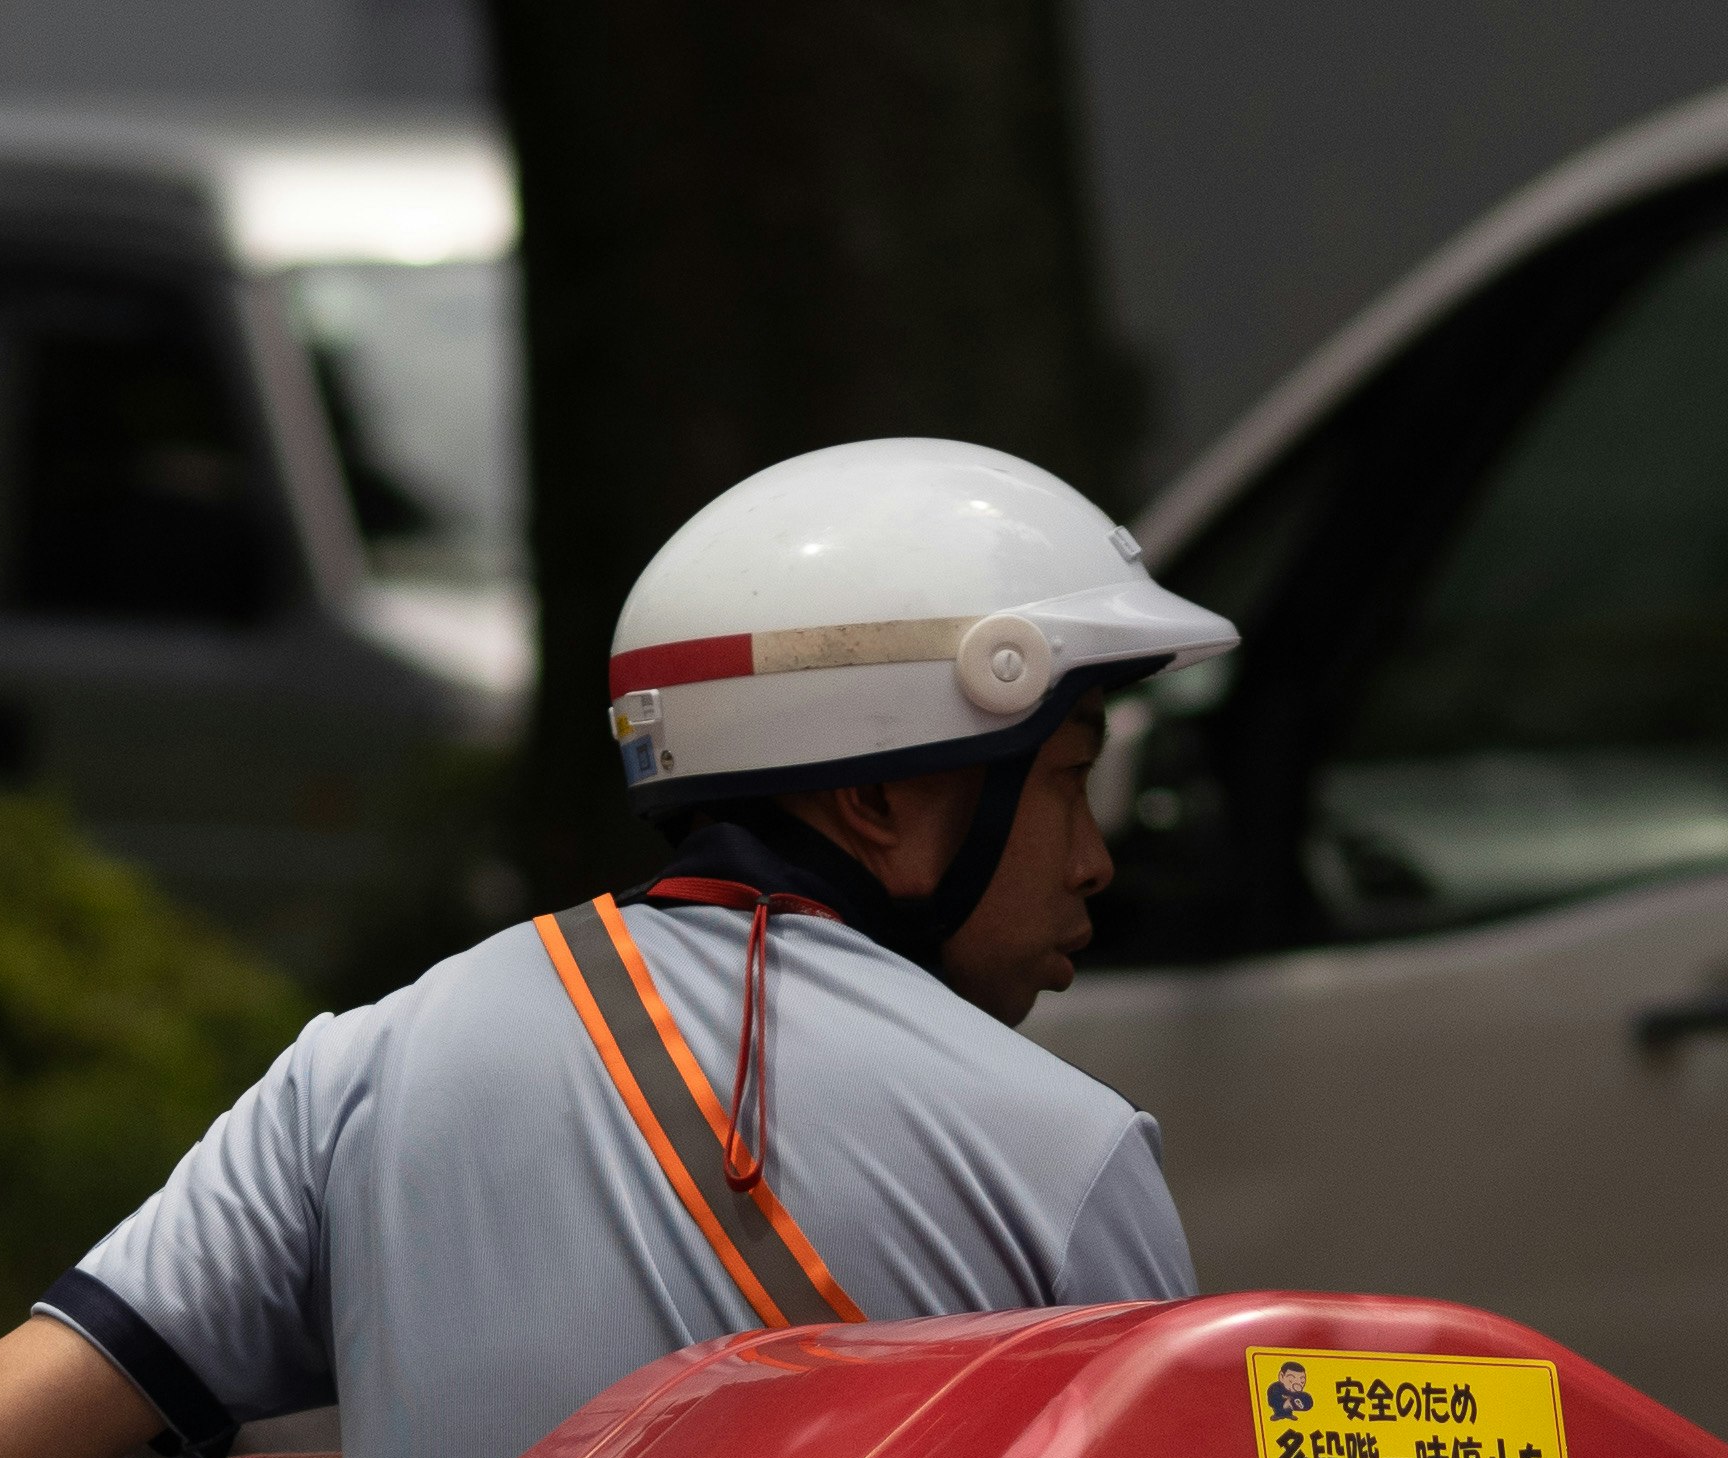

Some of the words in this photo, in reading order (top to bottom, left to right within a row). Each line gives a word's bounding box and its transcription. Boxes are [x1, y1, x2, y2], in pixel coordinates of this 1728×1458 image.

[1334, 1376, 1478, 1425] 安全のため
